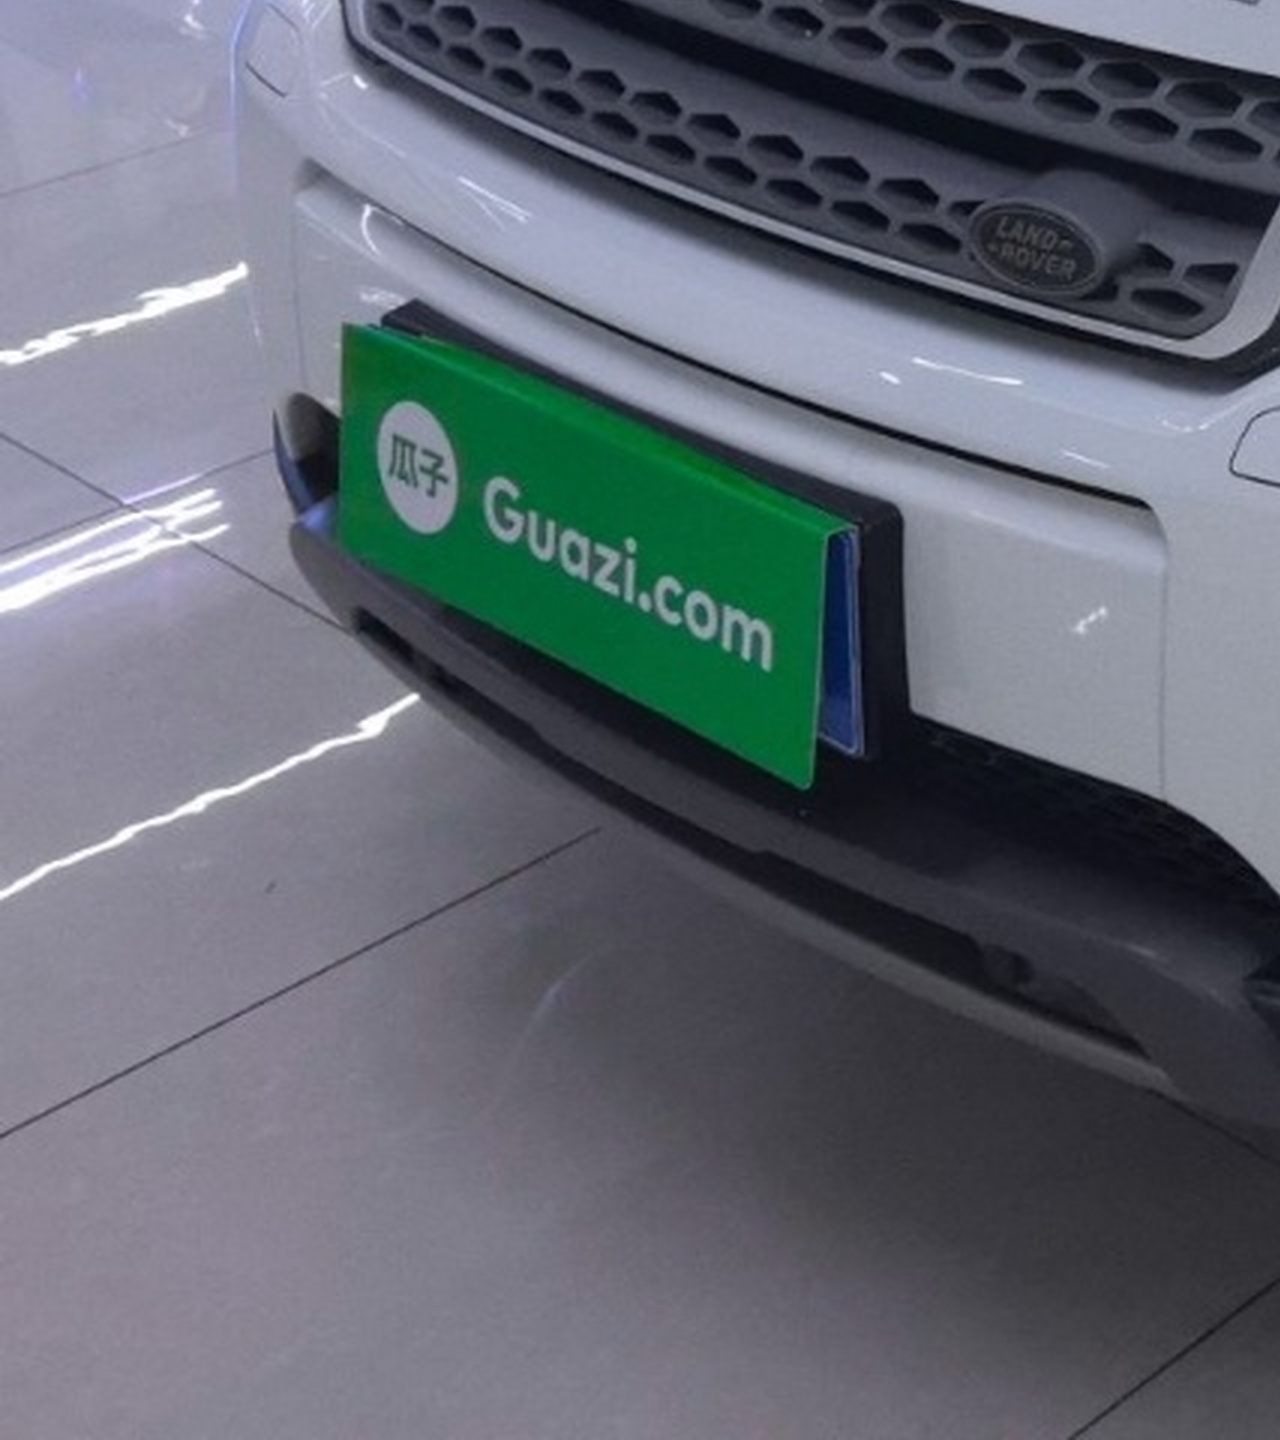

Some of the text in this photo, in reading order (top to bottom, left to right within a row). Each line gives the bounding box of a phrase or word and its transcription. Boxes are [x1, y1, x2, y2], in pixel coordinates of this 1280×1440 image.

[996, 215, 1059, 250] LAND
[1000, 242, 1077, 281] ROVER
[387, 432, 450, 499] 瓜子
[482, 475, 773, 673] Guazi.com
